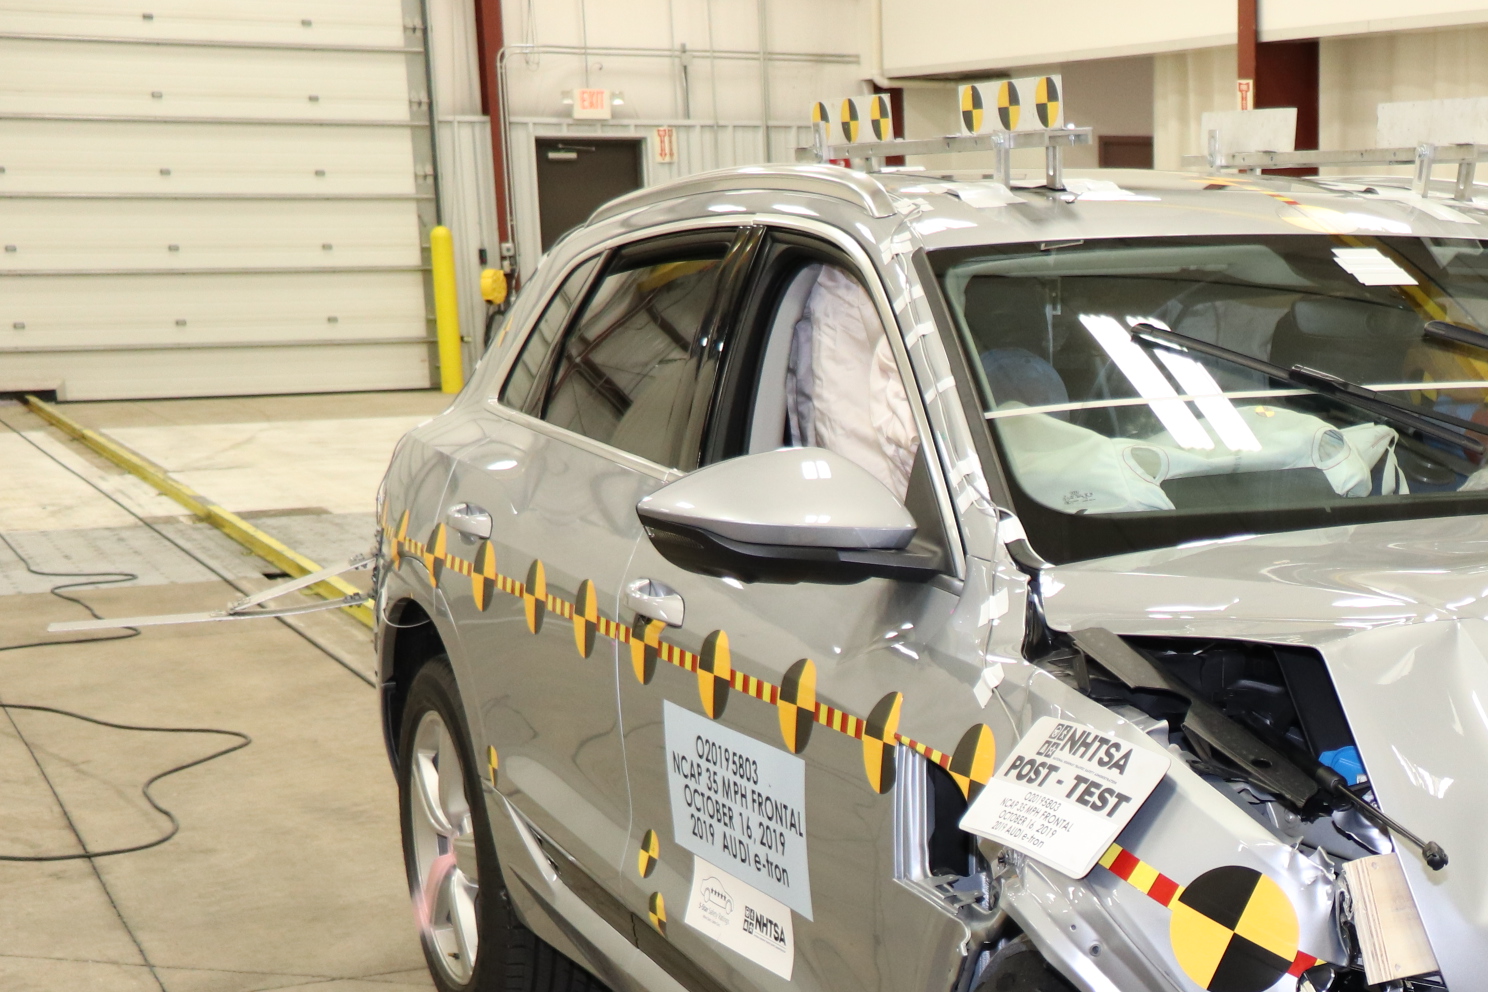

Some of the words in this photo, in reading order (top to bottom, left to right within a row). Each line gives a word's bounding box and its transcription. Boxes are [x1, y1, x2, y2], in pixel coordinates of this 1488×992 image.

[579, 90, 605, 110] EXIT
[1060, 730, 1134, 776] NHTSA
[672, 750, 703, 785] NCAP
[706, 767, 719, 795] 35
[722, 776, 749, 810] MPH
[751, 789, 804, 838] FRONTAL
[1004, 755, 1061, 787] POST
[1065, 774, 1133, 818] TEST
[683, 783, 736, 831] OCTOBER
[739, 812, 757, 845] 16,
[759, 822, 786, 857] 2019
[991, 821, 1006, 833] 2019
[1004, 824, 1024, 839] AUDI
[1021, 833, 1045, 849] e-tron
[998, 809, 1029, 828] OCTOBER
[1036, 823, 1058, 839] 2019
[1000, 797, 1018, 812] NCAP
[1016, 802, 1027, 813] 35
[1025, 805, 1041, 818] MPH
[1042, 809, 1075, 833] FRONTAL
[690, 813, 715, 846] 2019
[722, 831, 752, 867] AUDI
[754, 853, 790, 888] e-tron
[755, 912, 787, 947] NHTSA
